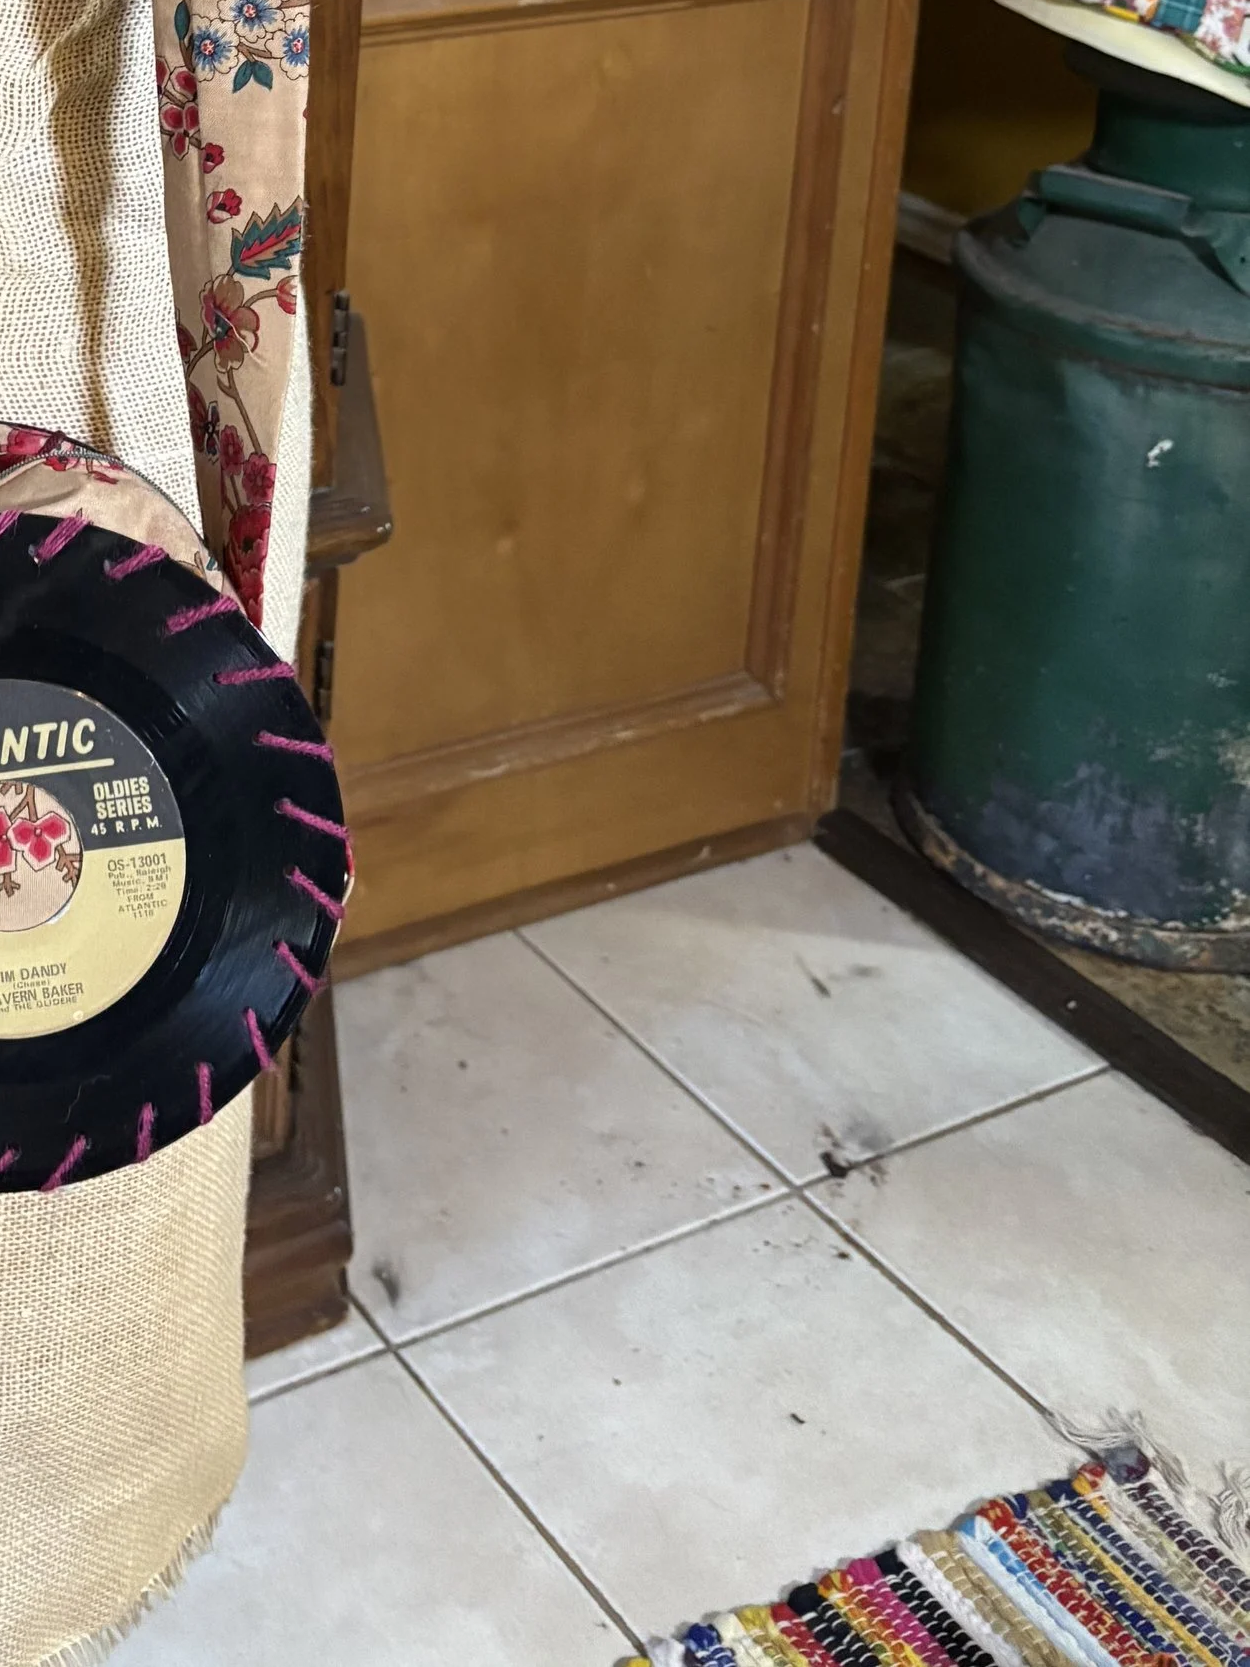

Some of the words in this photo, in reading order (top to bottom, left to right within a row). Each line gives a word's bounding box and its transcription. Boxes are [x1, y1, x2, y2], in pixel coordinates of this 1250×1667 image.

[93, 776, 150, 801] OLDIES
[95, 795, 152, 820] SERIES
[90, 821, 107, 836] 45
[107, 852, 167, 872] OS-13001
[118, 899, 168, 913] ATLANTIC
[127, 892, 155, 903] FROM
[20, 962, 67, 981] DANDY
[41, 982, 85, 1000] BAKER
[14, 1002, 32, 1012] THE
